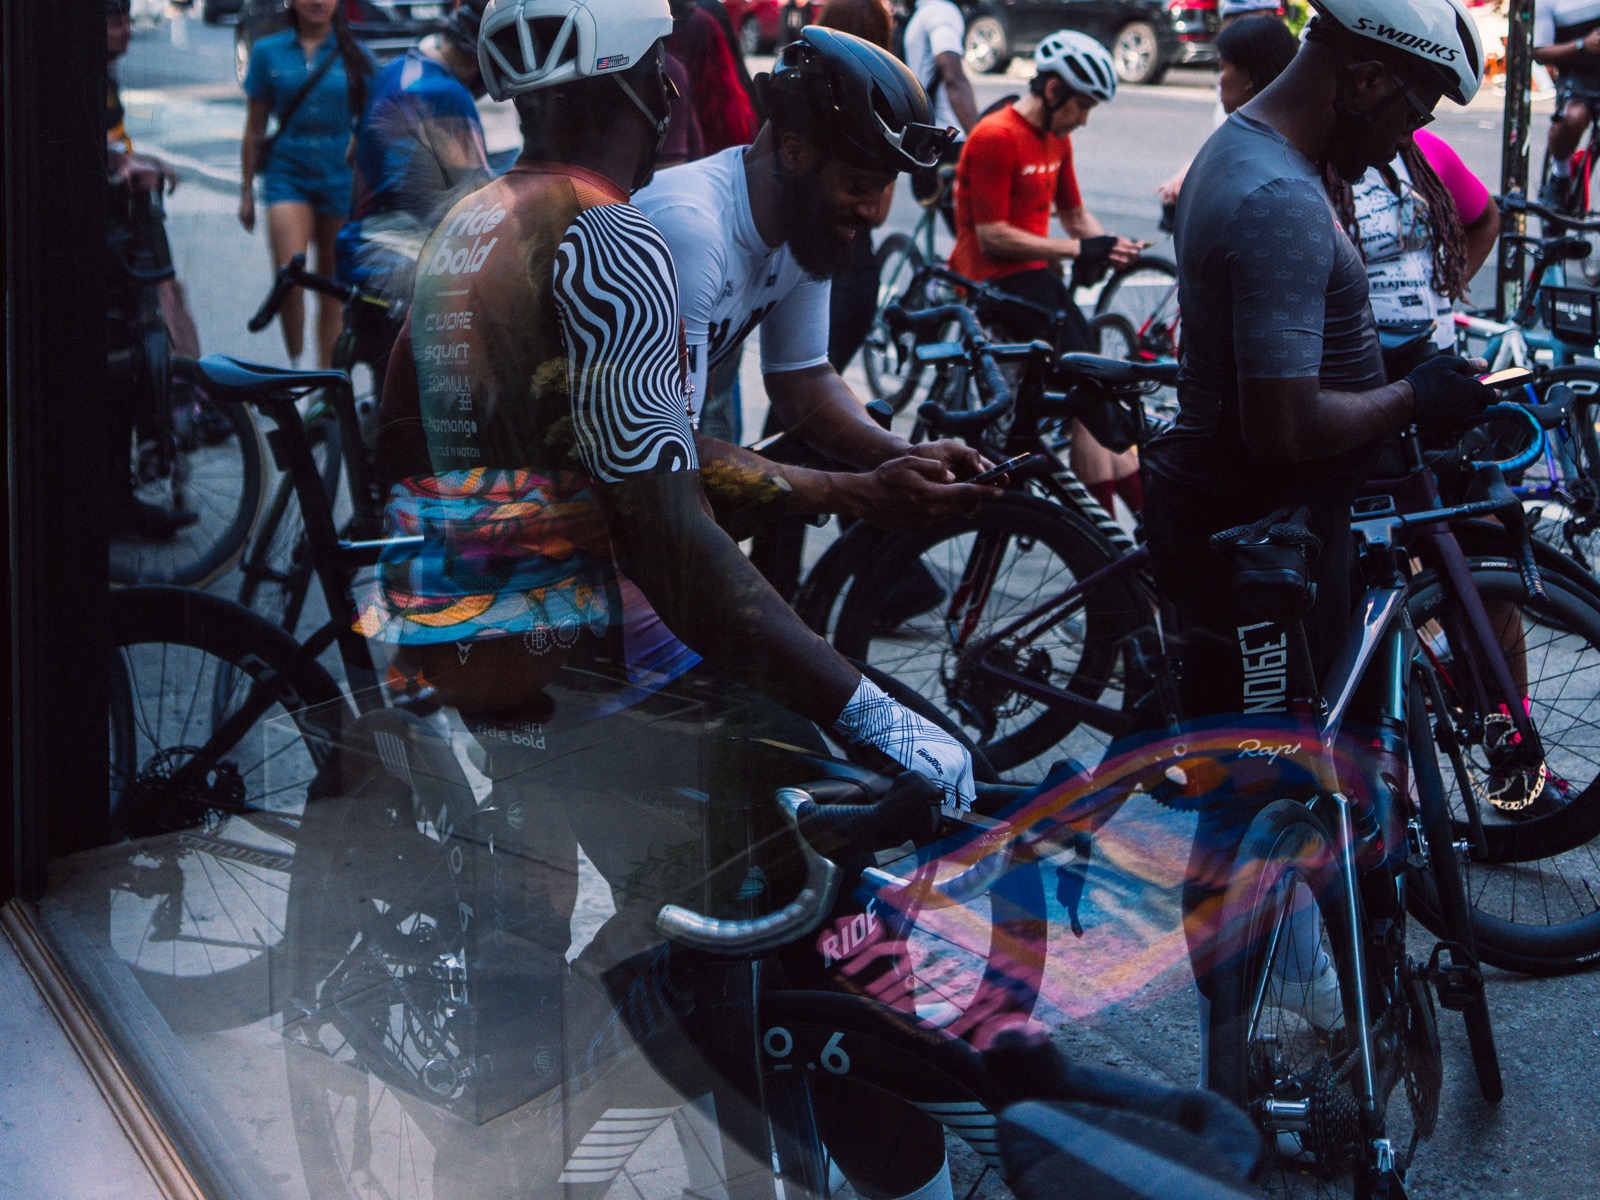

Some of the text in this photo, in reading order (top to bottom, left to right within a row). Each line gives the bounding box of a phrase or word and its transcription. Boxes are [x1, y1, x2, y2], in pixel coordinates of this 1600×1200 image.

[1351, 17, 1460, 62] S-WORKS
[445, 202, 506, 237] ride
[427, 236, 498, 276] bold
[424, 342, 470, 365] squirt
[428, 375, 471, 394] FORMULA
[476, 723, 547, 750] ride bold
[822, 897, 877, 969] RIDE
